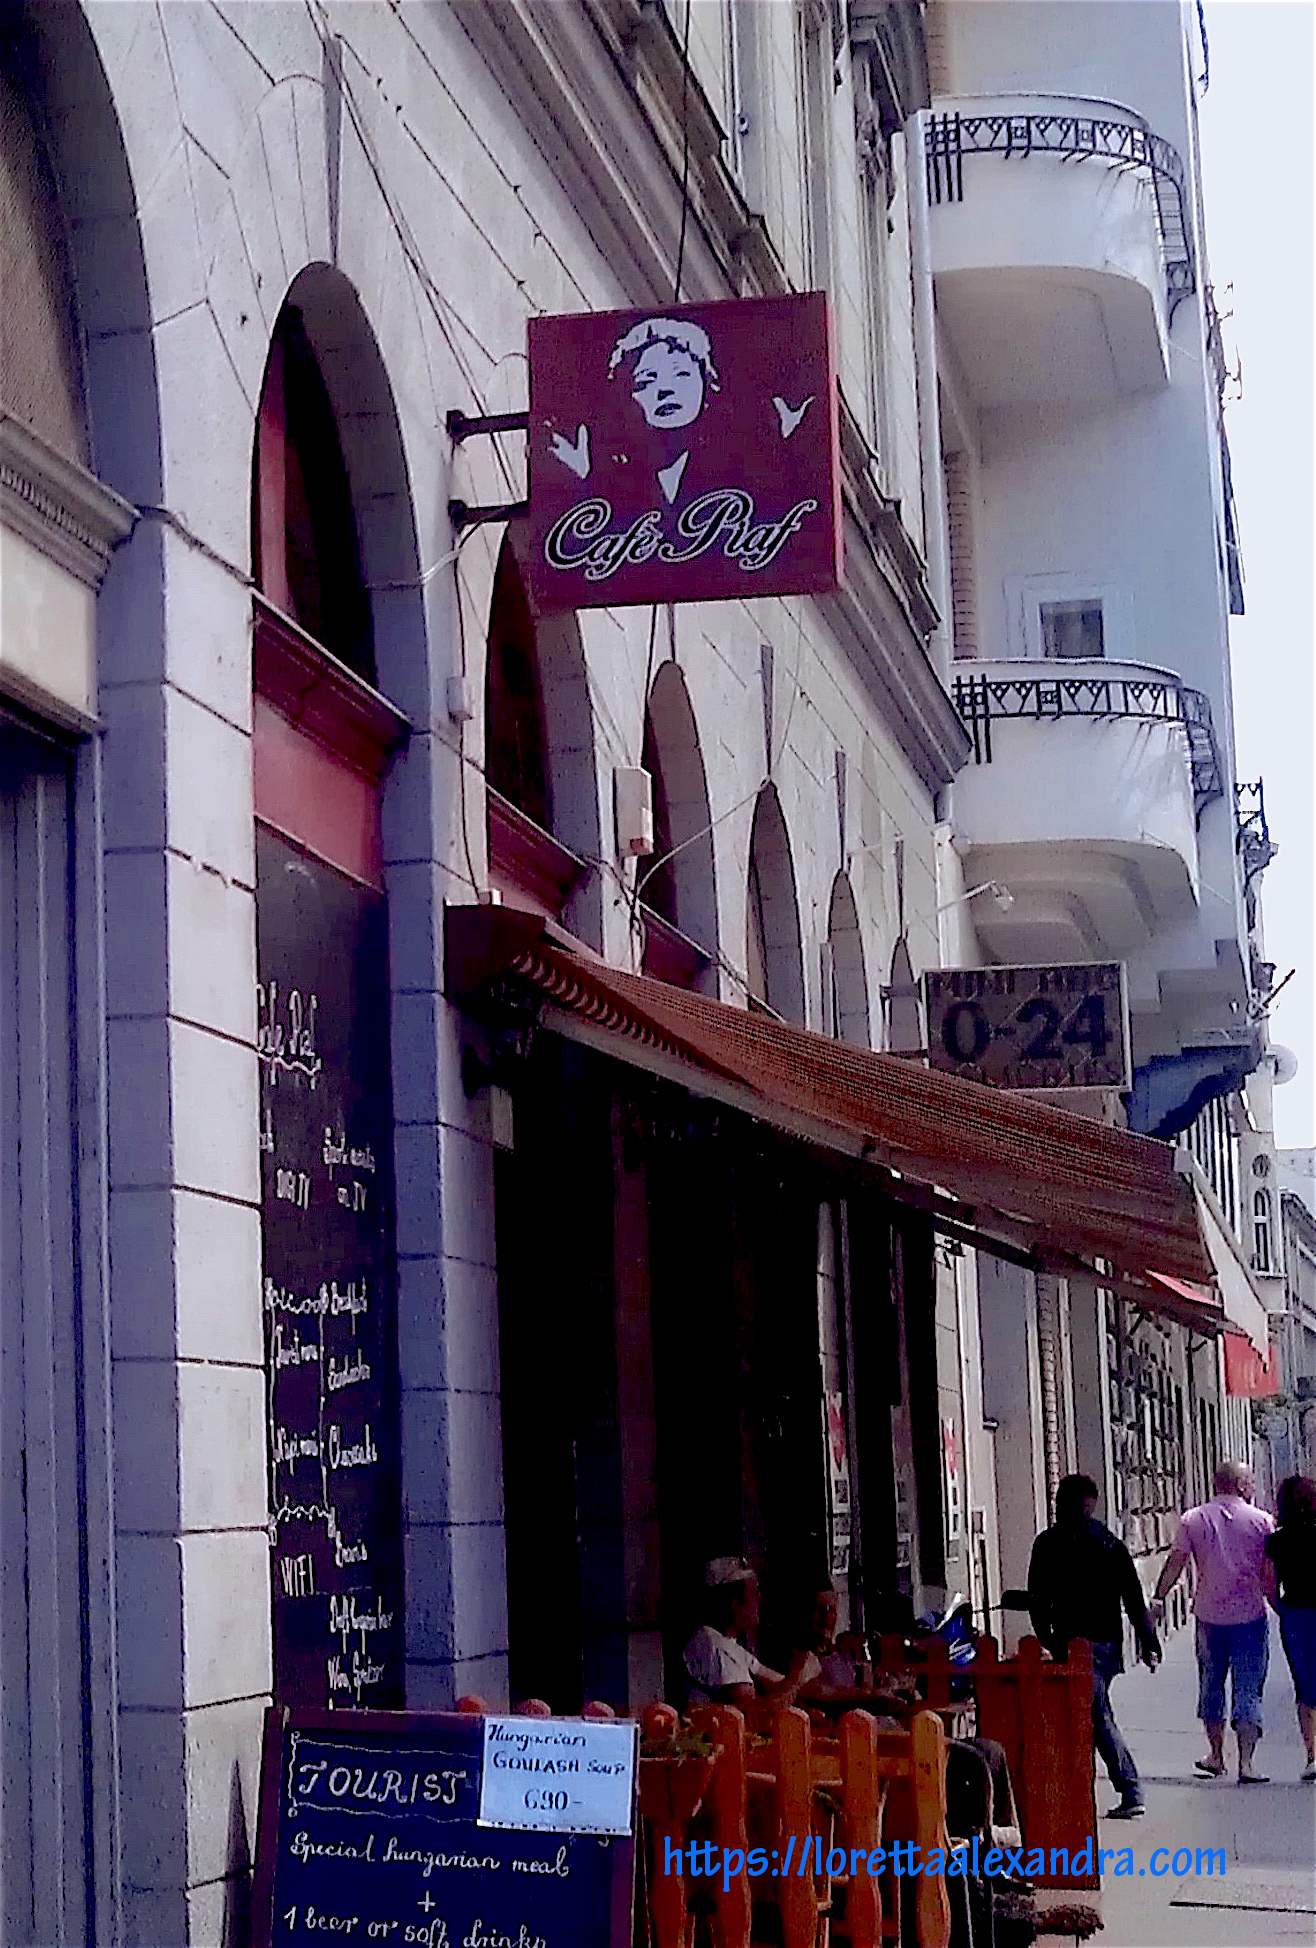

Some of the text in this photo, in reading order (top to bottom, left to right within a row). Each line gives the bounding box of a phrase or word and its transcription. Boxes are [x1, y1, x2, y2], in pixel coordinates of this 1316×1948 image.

[658, 488, 818, 571] Piaf
[941, 995, 1113, 1064] 0-24
[488, 1723, 587, 1752] Hungarian
[299, 1760, 467, 1805] TOURIST
[289, 1831, 571, 1878] Special hungarian meal
[283, 1905, 297, 1931] 1
[303, 1906, 359, 1934] beer
[367, 1920, 399, 1938] or
[403, 1918, 451, 1948] soft
